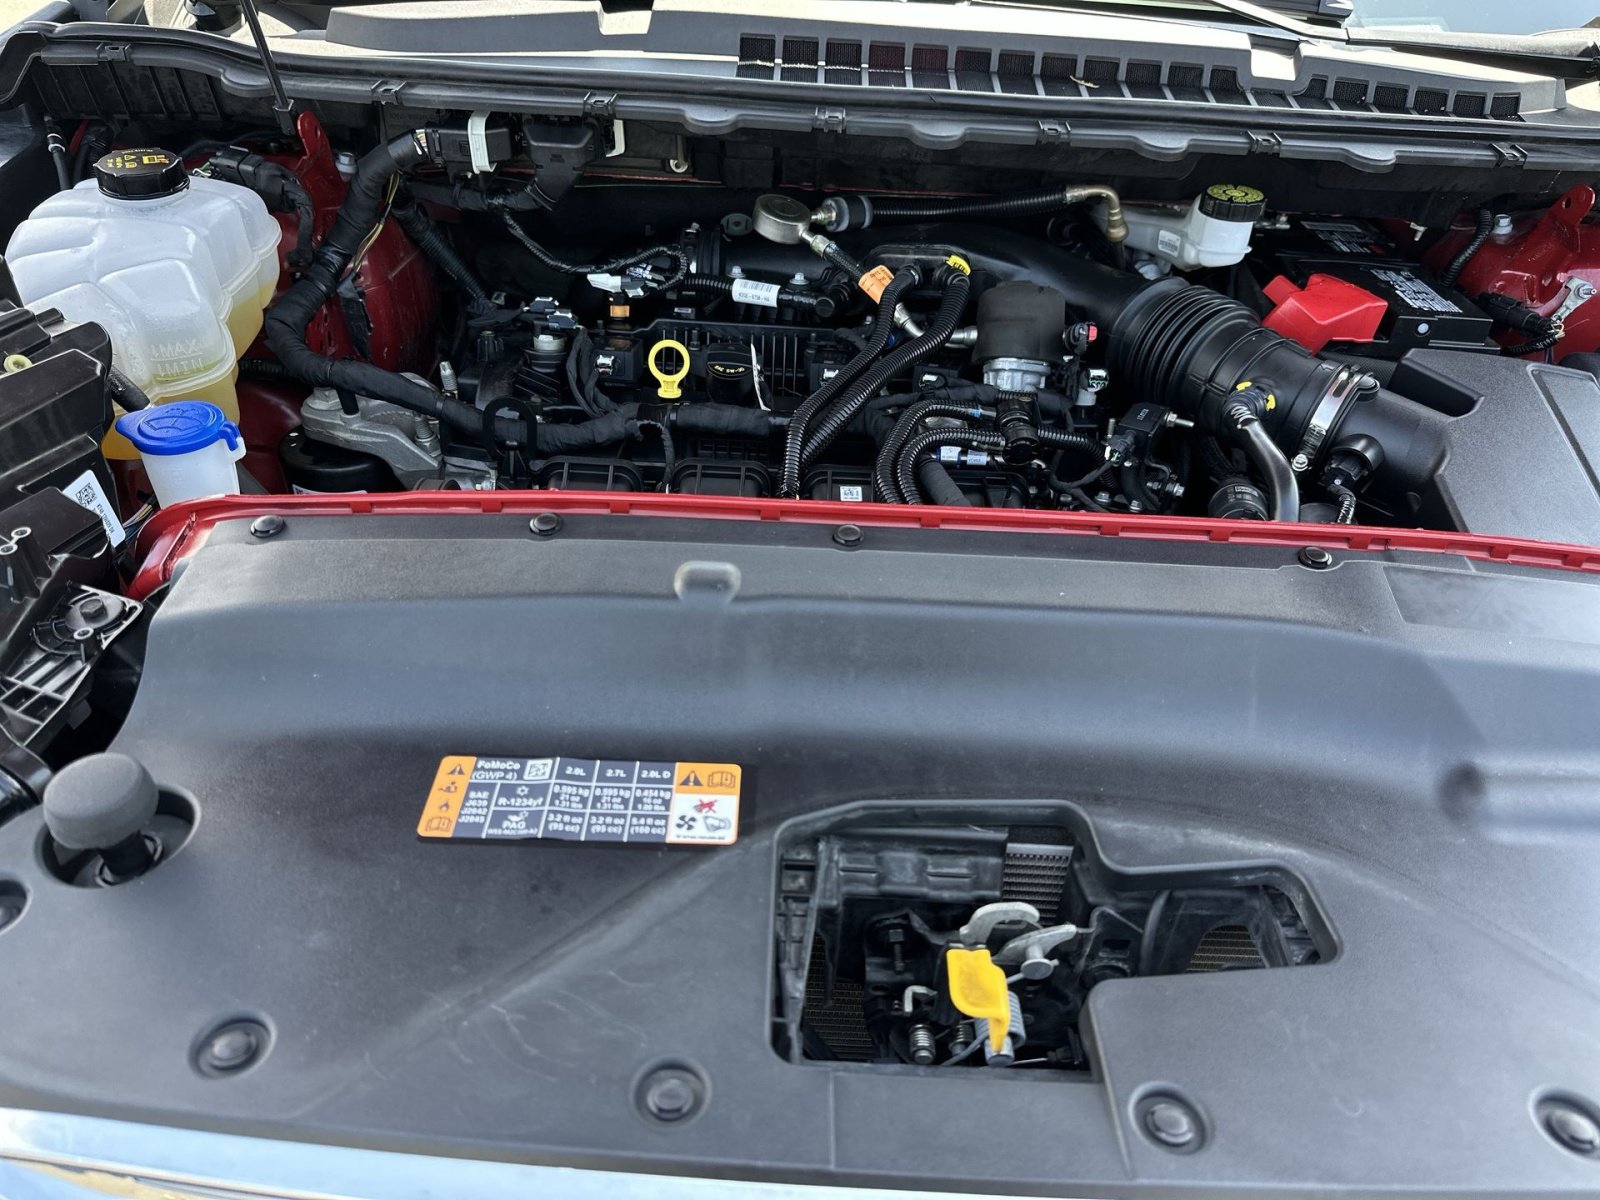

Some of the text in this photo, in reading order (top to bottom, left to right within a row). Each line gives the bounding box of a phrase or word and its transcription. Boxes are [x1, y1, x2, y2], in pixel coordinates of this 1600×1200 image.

[477, 760, 521, 769] FoMoCo
[472, 770, 517, 781] (GWP 4)
[565, 766, 586, 776] 2.0L
[606, 769, 626, 778] 2.7L
[641, 770, 661, 778] 2.0L
[578, 788, 590, 797] kg
[619, 788, 630, 798] kg
[659, 789, 671, 800] kg
[498, 797, 543, 807] R-1234yf
[571, 816, 583, 824] oz
[502, 821, 526, 829] PAG
[564, 824, 580, 833] cc)
[607, 826, 622, 834] cc)
[651, 826, 666, 835] cc)
